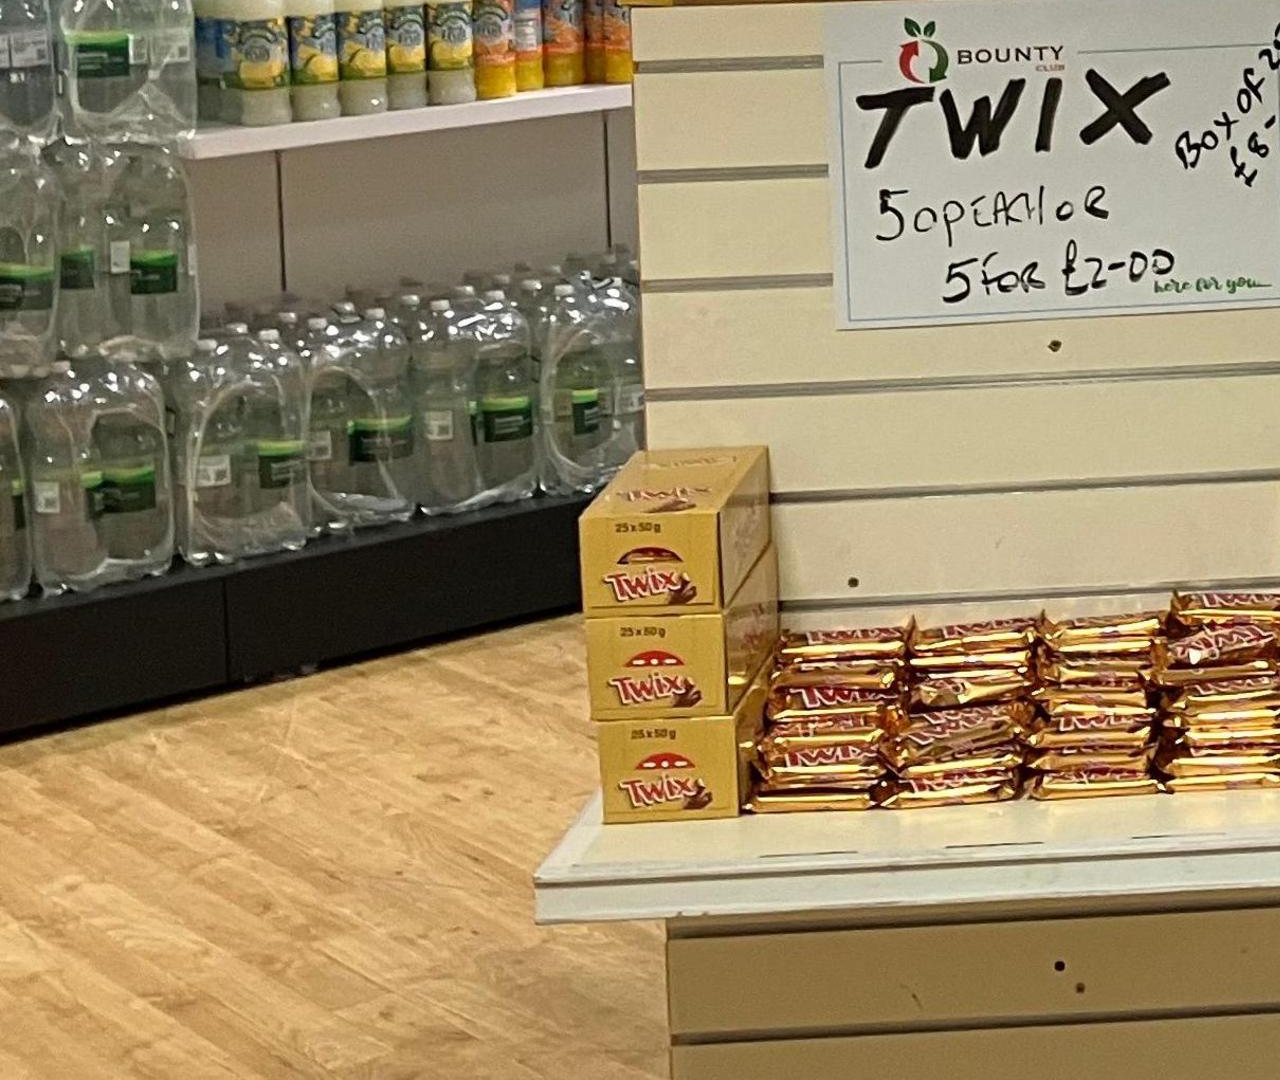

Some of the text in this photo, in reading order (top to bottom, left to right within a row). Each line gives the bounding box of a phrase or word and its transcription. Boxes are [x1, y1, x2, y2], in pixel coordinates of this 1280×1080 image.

[956, 45, 1065, 65] BOUNTY
[1035, 63, 1066, 73] CLUB
[855, 68, 1172, 170] TWIX
[1153, 278, 1192, 294] here
[1195, 276, 1223, 293] for
[604, 567, 684, 603] Twix
[609, 672, 690, 706] Twix
[619, 774, 700, 810] Twix
